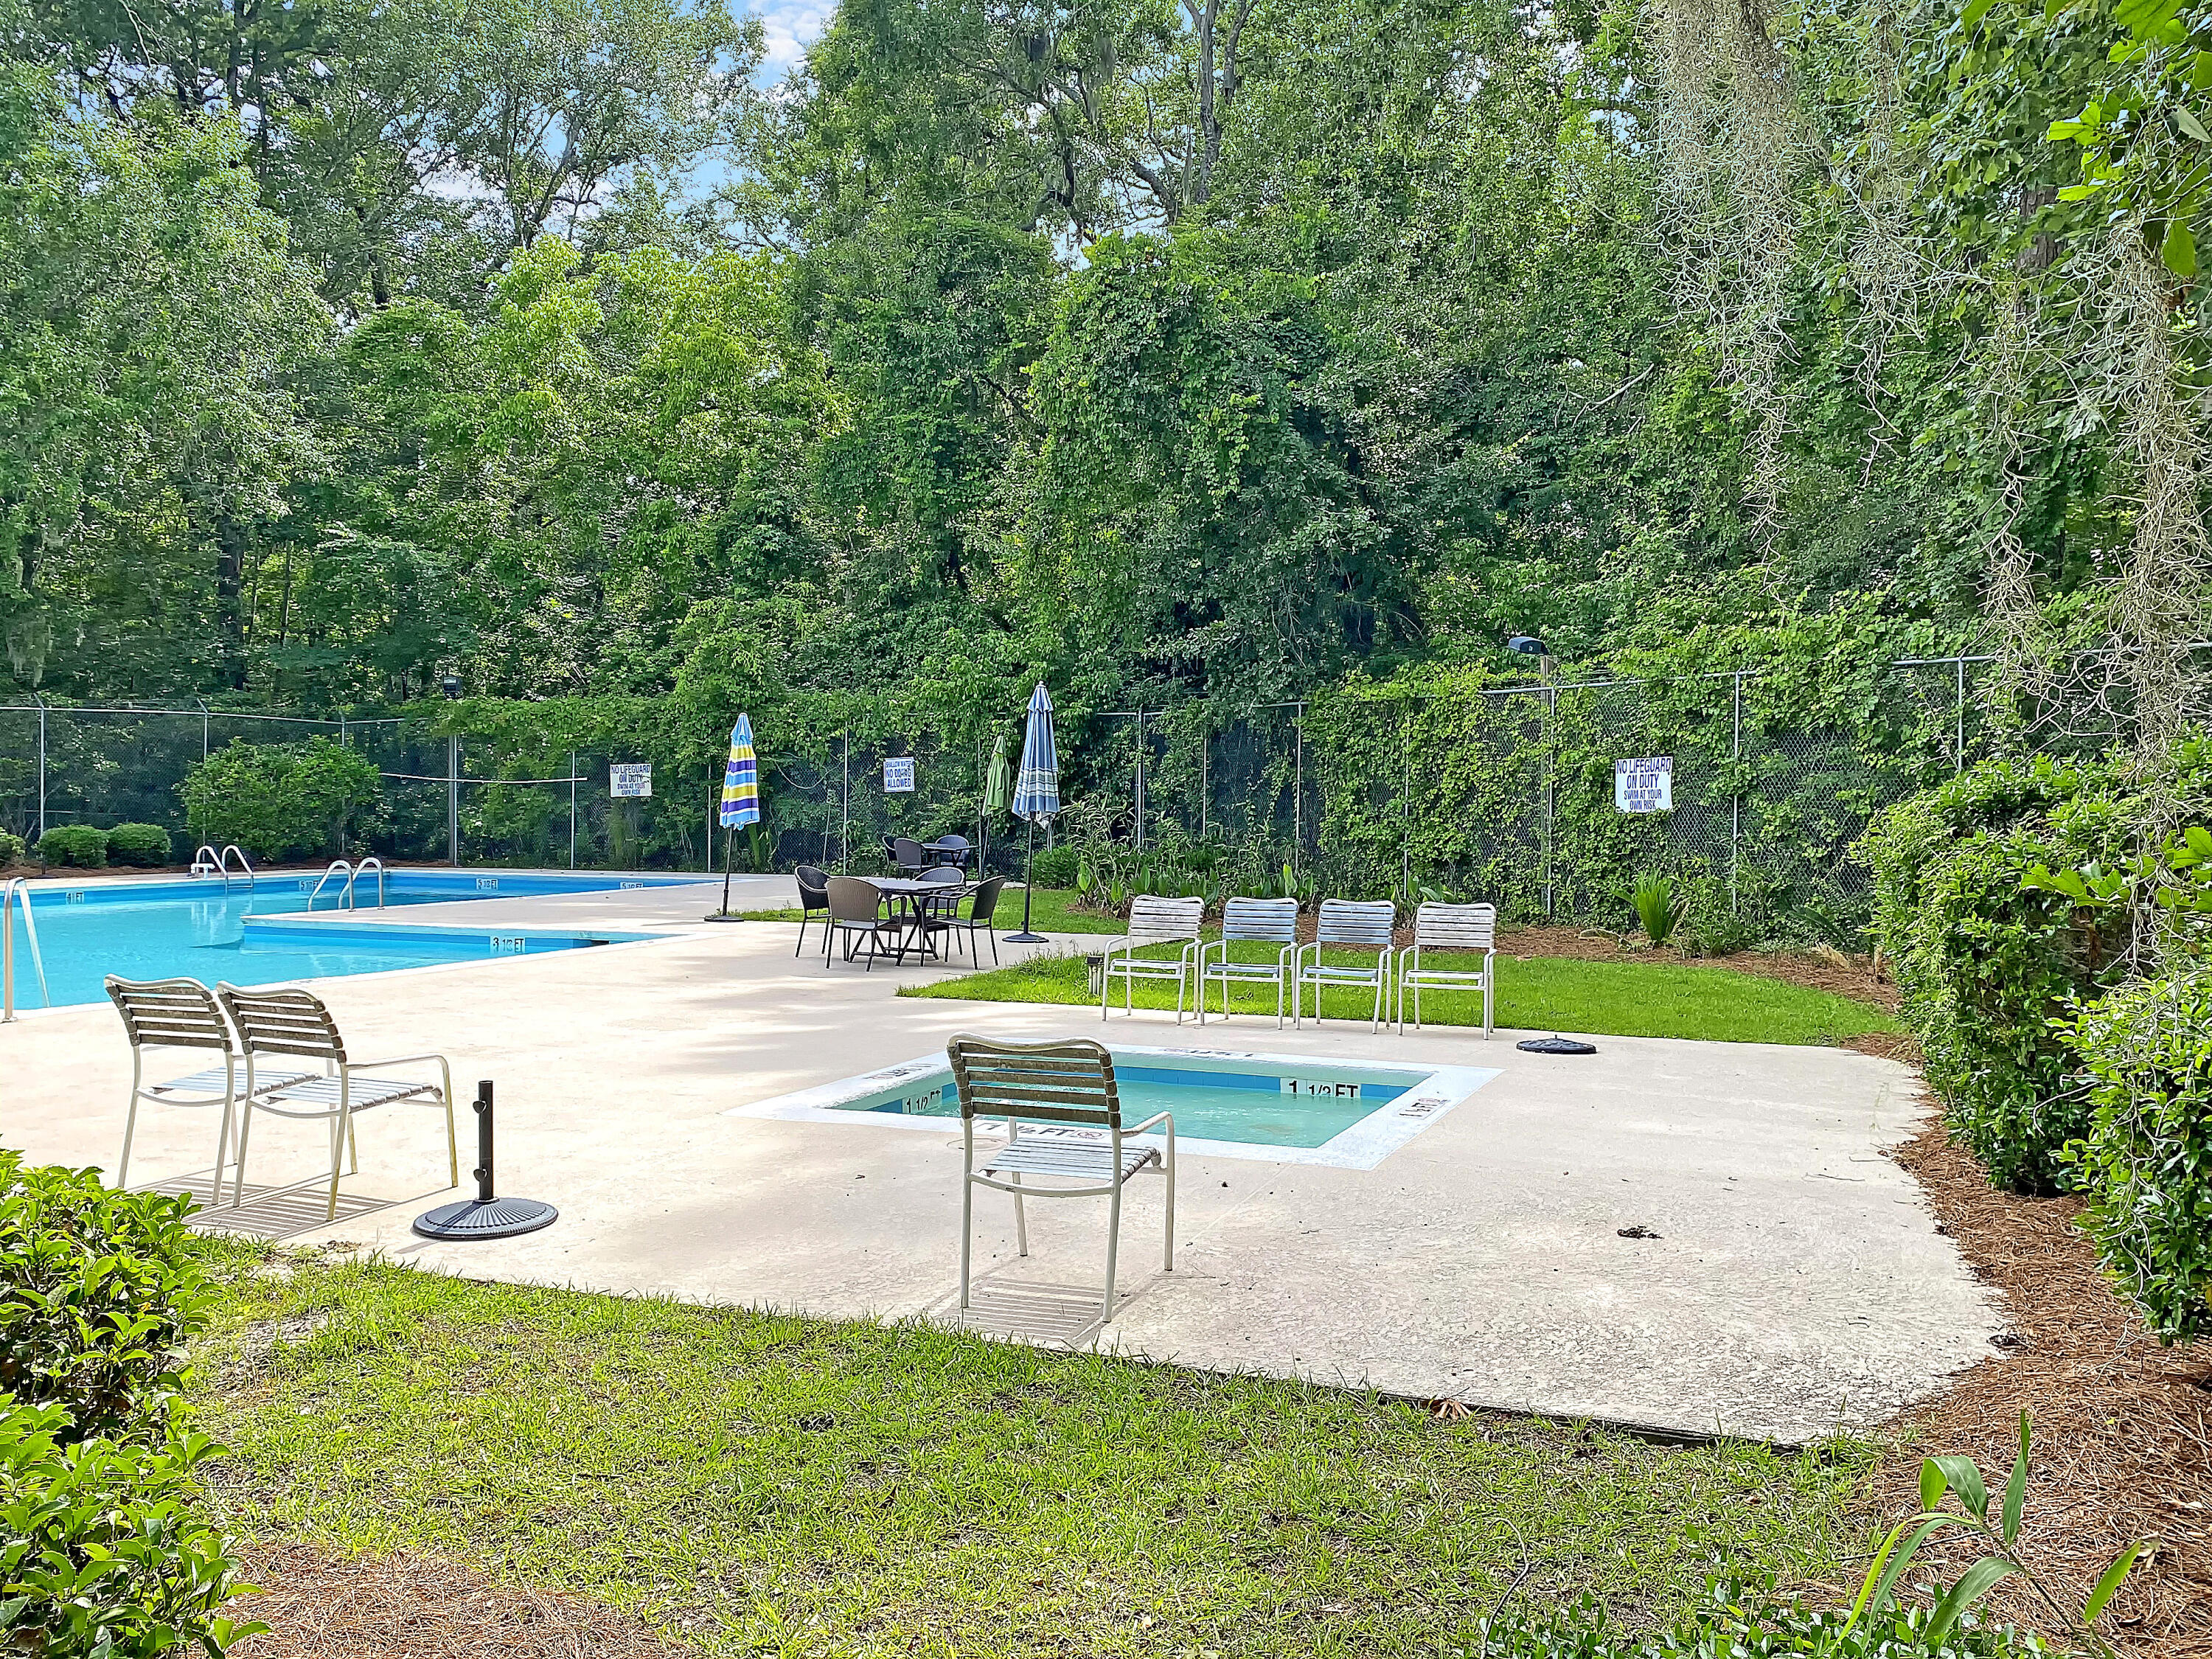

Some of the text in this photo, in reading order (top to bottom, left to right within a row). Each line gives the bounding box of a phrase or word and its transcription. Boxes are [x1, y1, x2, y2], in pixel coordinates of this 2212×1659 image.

[611, 765, 650, 774] NO LIFEGUARD
[1616, 757, 1671, 774] NO LIFEGUARD
[619, 774, 643, 783] ON DUTY
[886, 769, 894, 778] NO
[887, 778, 911, 787] ALLOWED
[1627, 773, 1660, 789] ON DUTY
[1624, 789, 1662, 800] SWIM AT YOUR
[1630, 800, 1656, 810] OWN RISK
[493, 937, 499, 951] 3
[515, 938, 524, 953] FT
[1289, 1079, 1358, 1098] 1 1/2 FT
[906, 1098, 911, 1113] 1
[916, 1096, 928, 1111] 1/2
[1038, 1127, 1074, 1136] FT
